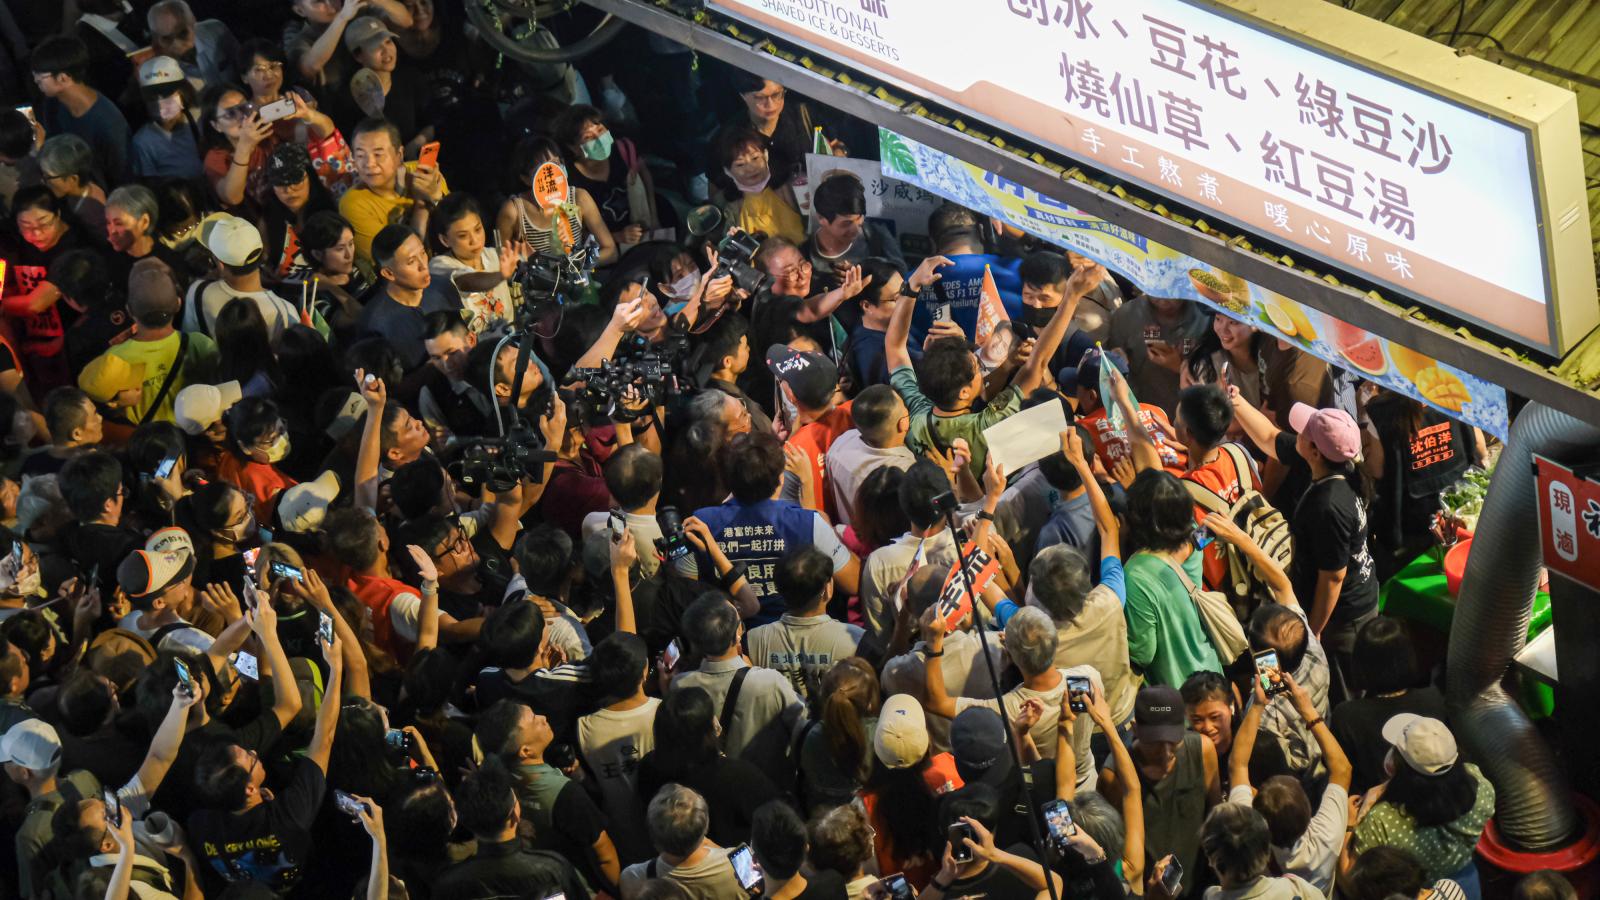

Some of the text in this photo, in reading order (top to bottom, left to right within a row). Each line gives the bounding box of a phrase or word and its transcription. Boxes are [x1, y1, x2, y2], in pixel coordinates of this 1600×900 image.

[761, 0, 900, 61] SHAVED ICE & DESSERTS
[1059, 51, 1415, 241] 燒仙草、紅豆湯
[1411, 431, 1452, 455] 沈伯洋
